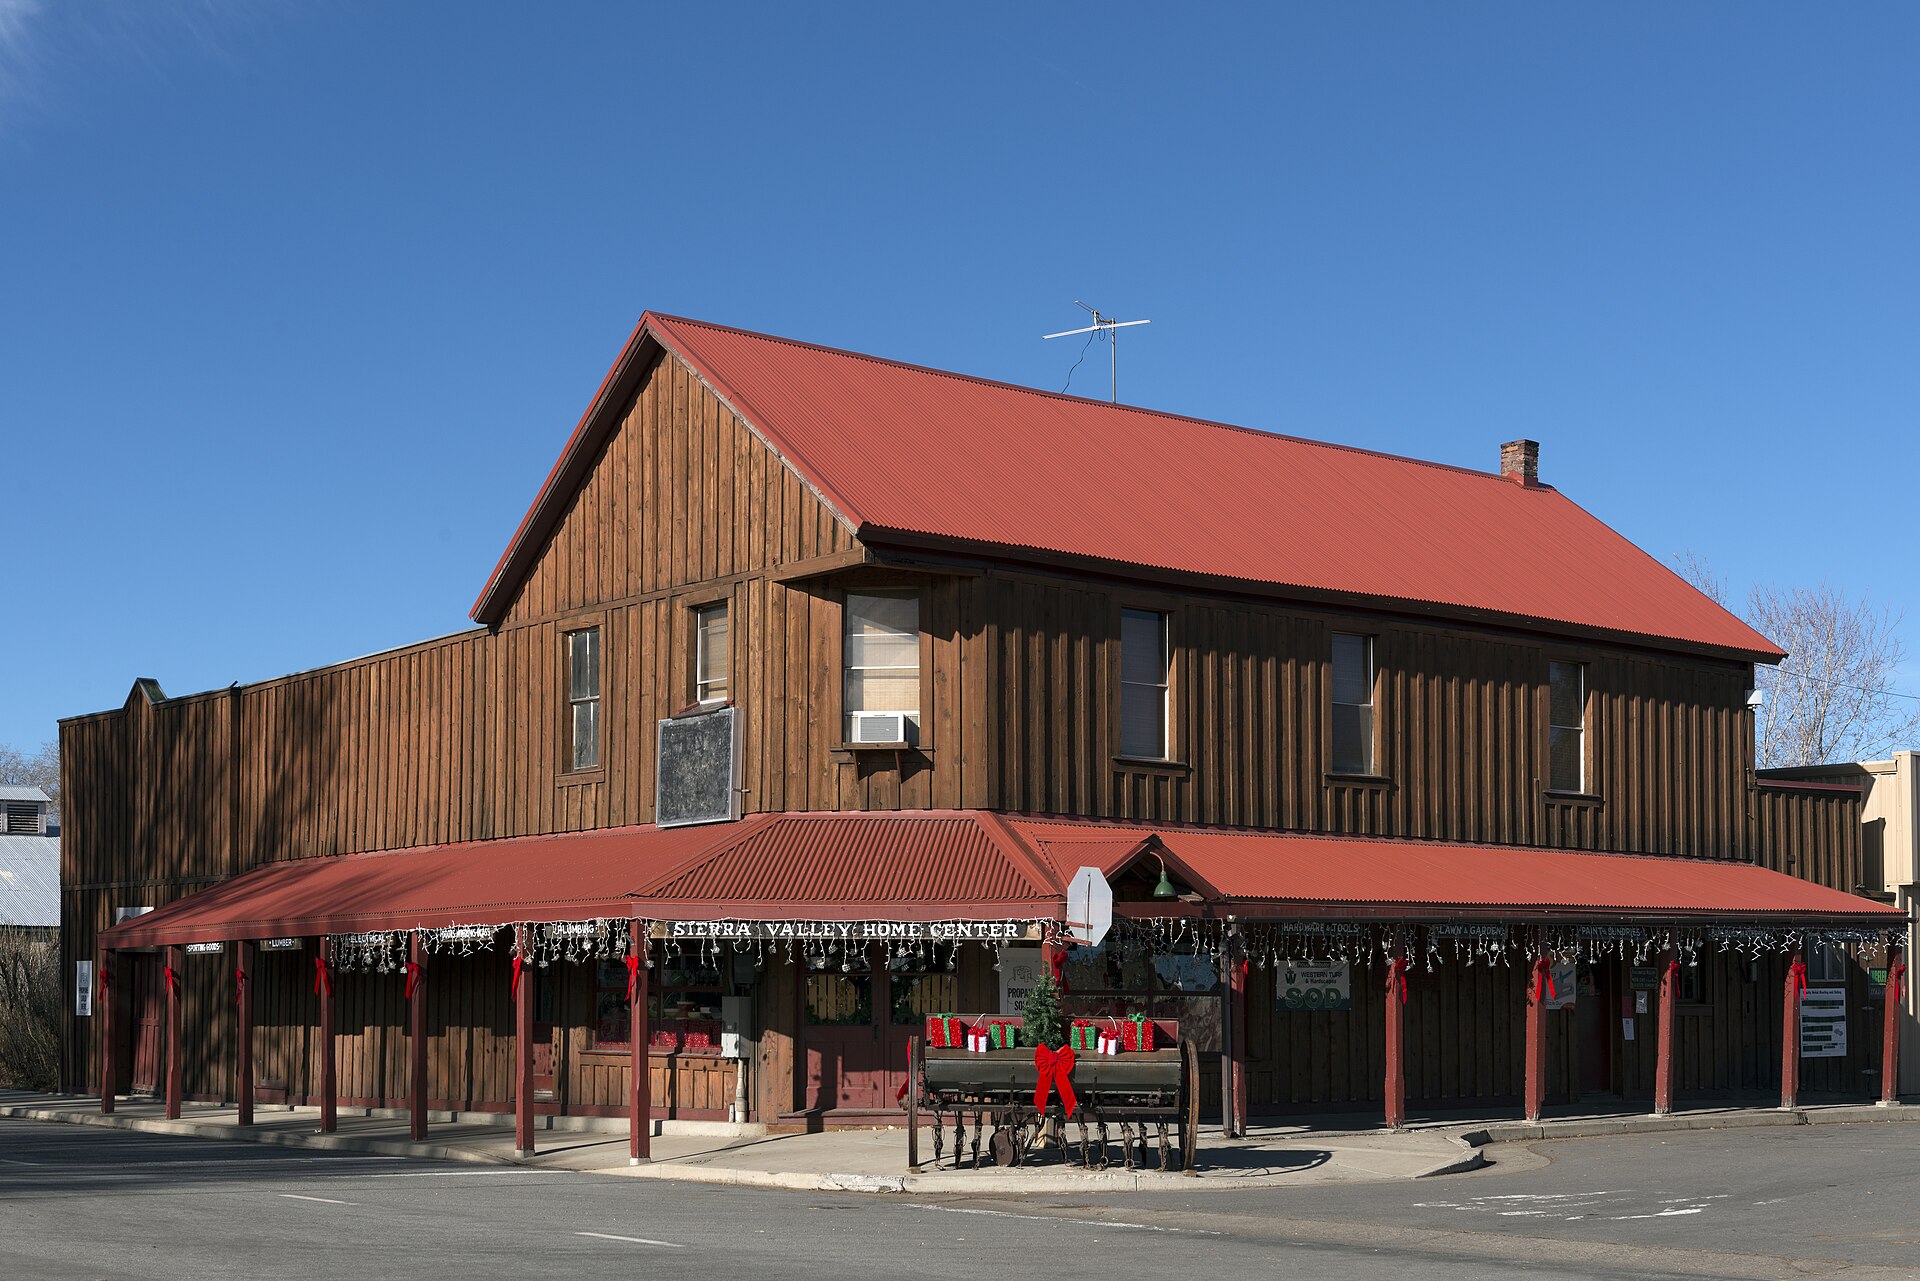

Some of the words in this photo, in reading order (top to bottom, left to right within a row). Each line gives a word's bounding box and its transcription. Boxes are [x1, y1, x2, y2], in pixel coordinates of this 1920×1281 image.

[557, 923, 595, 935] PLUMBING
[673, 921, 752, 937] SIERRA
[765, 921, 852, 937] VALLEY
[862, 922, 921, 937] HOME
[931, 922, 1019, 938] CENTER
[1283, 922, 1325, 932] HARDWARE
[1331, 922, 1359, 933] TOOLS
[1439, 925, 1462, 935] LAWN
[1469, 926, 1504, 936] GARDEN
[1581, 926, 1603, 936] PAINT
[271, 938, 294, 948] LUMBER
[1285, 987, 1342, 1009] SOD
